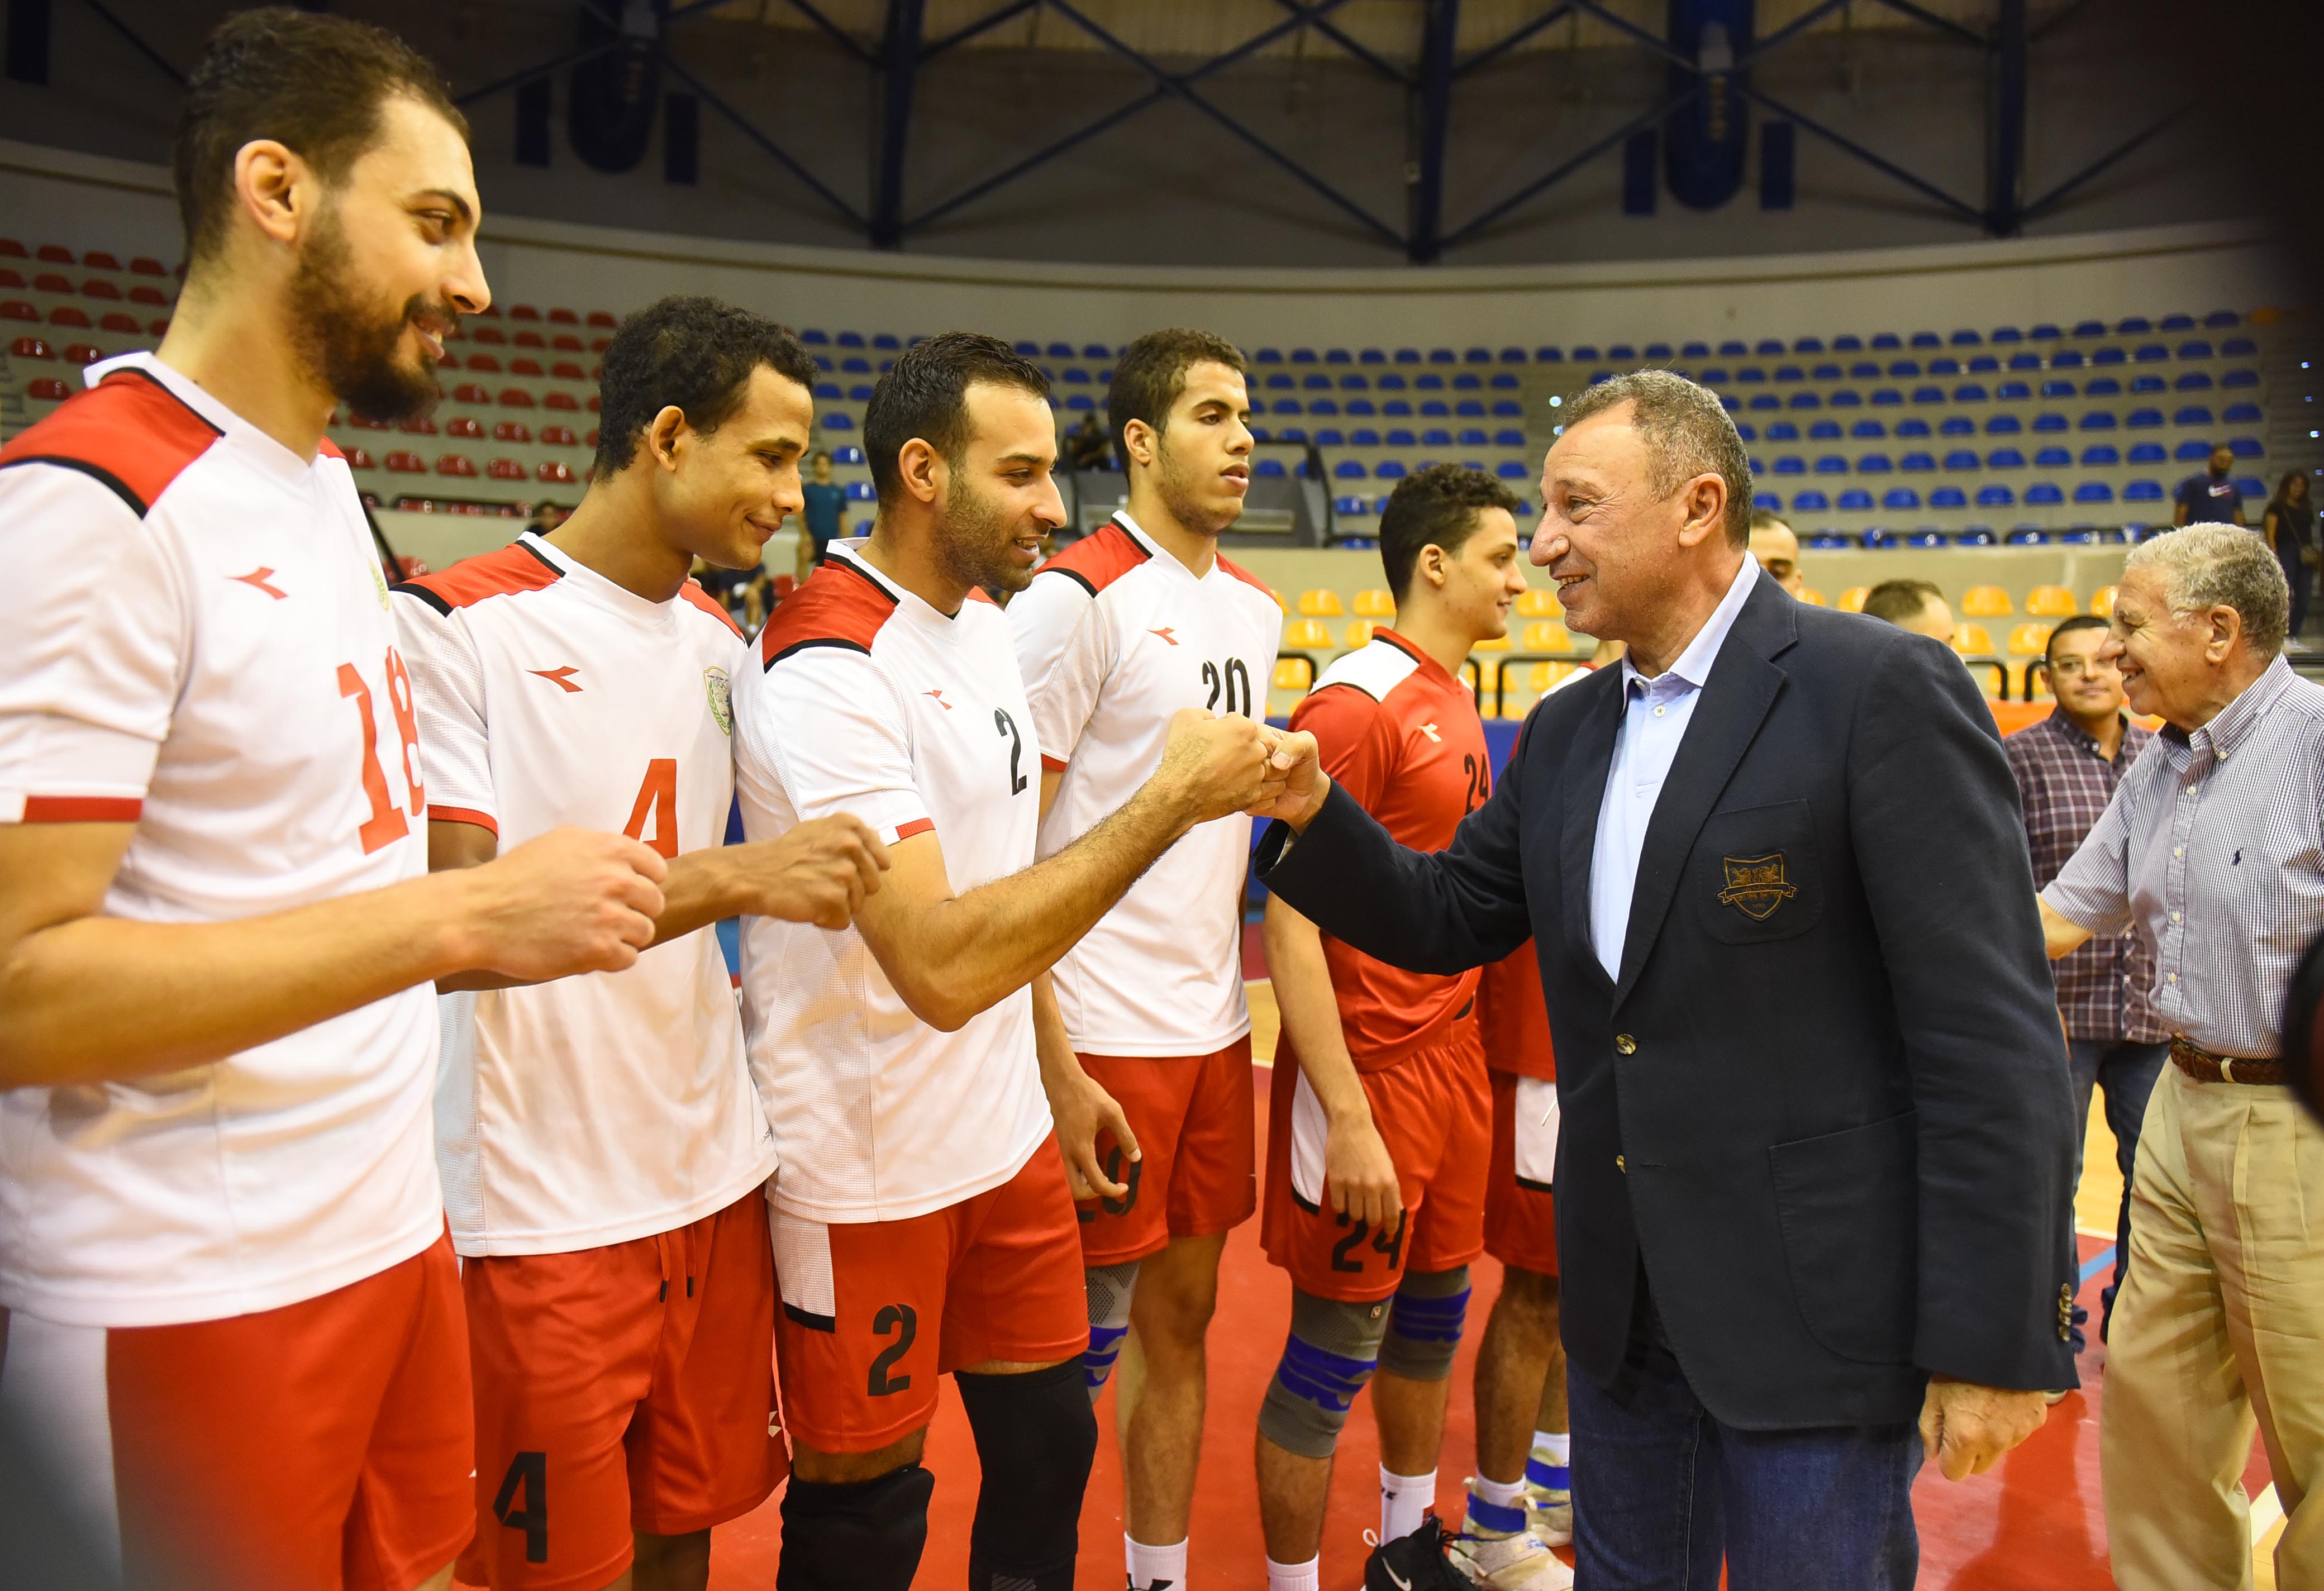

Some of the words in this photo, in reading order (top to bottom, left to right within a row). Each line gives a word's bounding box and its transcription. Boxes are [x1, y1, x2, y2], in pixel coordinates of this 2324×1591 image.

[1202, 657, 1251, 718] 20
[994, 707, 1027, 797] 2
[1464, 753, 1489, 816] 24
[622, 759, 678, 859] 4
[1332, 1208, 1407, 1273] 24
[868, 1303, 917, 1396] 2
[493, 1451, 547, 1563] 4
